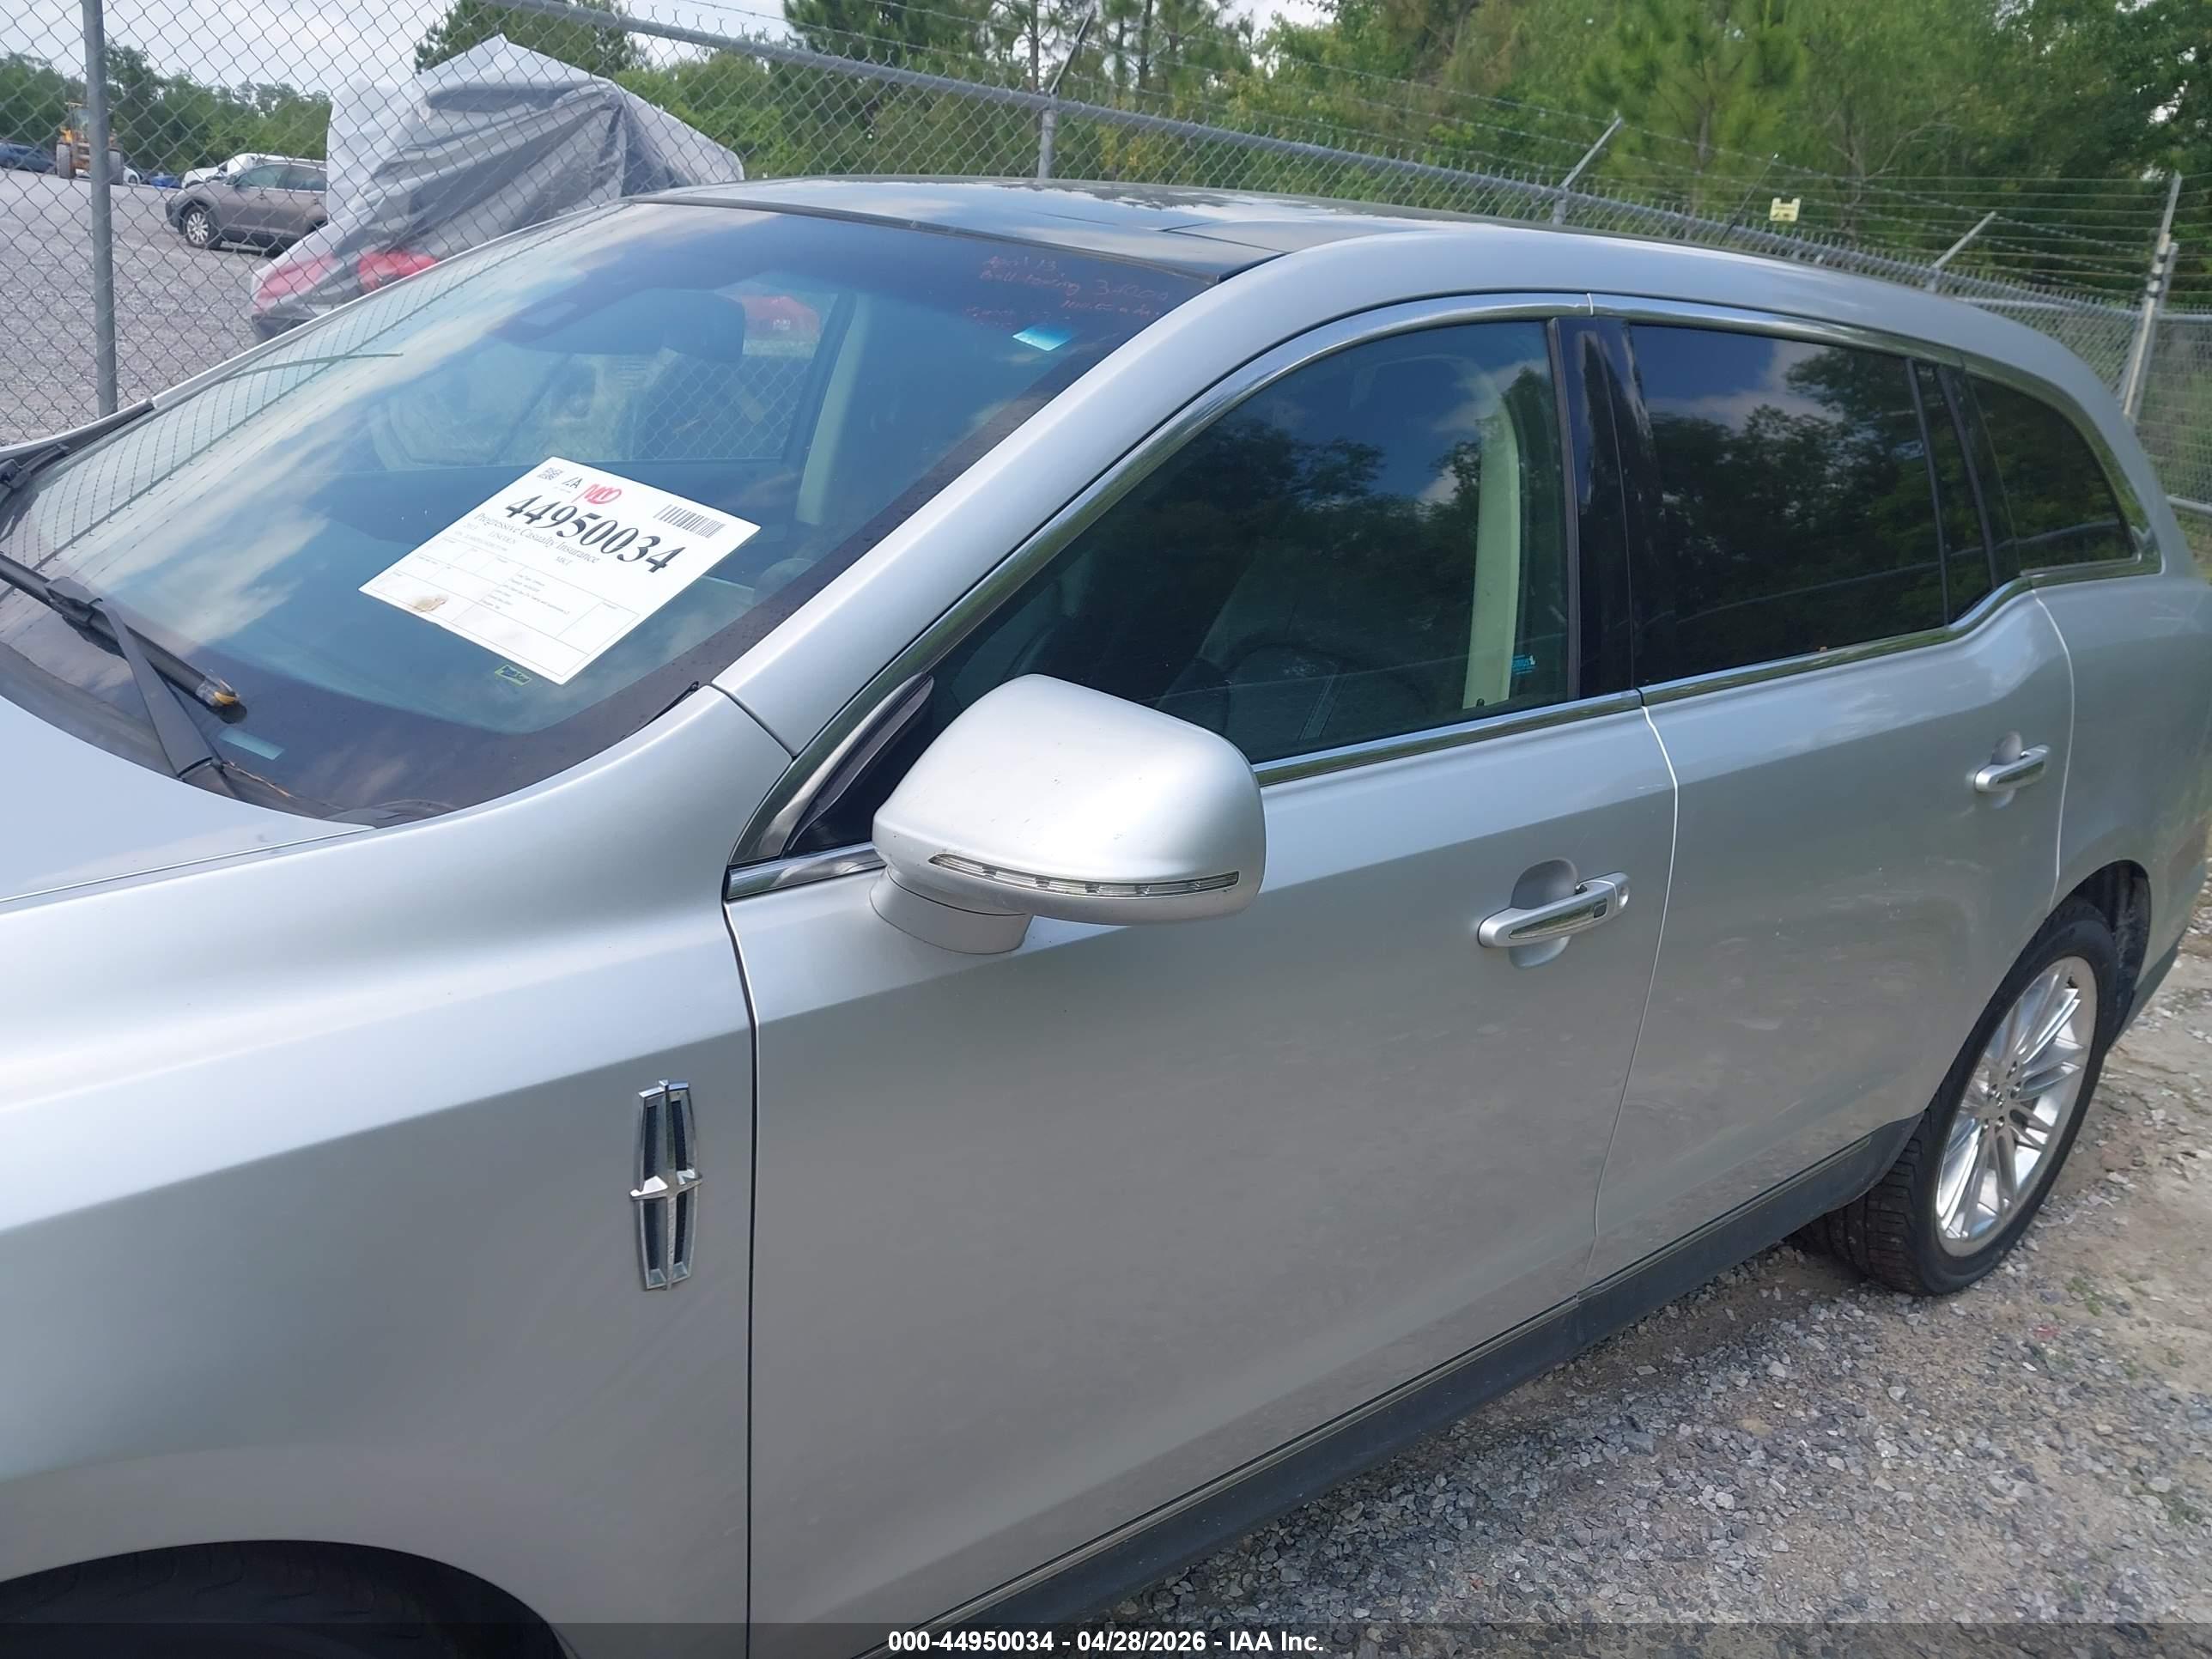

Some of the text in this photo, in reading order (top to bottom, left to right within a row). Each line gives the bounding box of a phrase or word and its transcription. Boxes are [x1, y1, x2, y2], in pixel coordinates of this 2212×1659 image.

[474, 513, 521, 533] Progressive
[520, 528, 556, 547] Casualty
[556, 541, 600, 563] Insurance
[505, 495, 686, 573] 44950034
